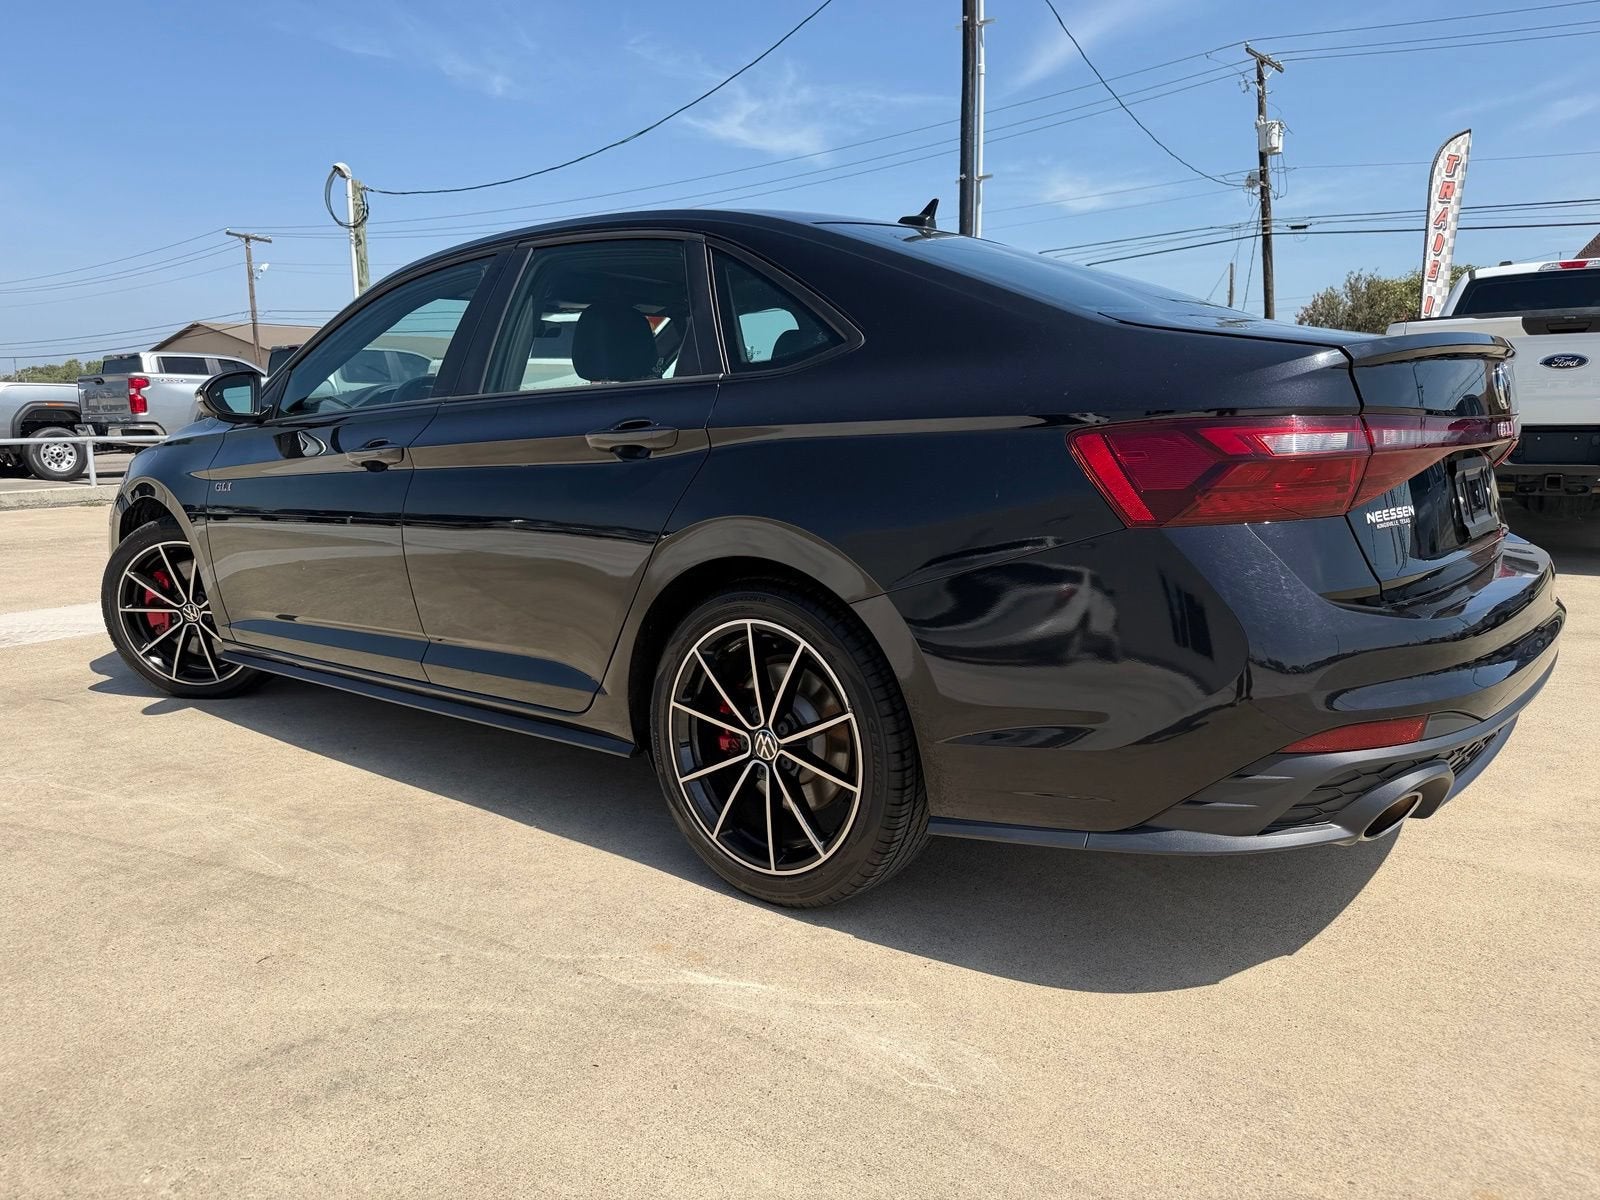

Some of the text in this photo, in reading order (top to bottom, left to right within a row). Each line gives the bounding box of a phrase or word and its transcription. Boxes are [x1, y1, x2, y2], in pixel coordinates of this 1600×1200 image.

[1424, 154, 1461, 316] TRADE I
[1551, 355, 1579, 369] Ford
[215, 482, 232, 492] GLI
[1366, 504, 1415, 525] NEESSEN
